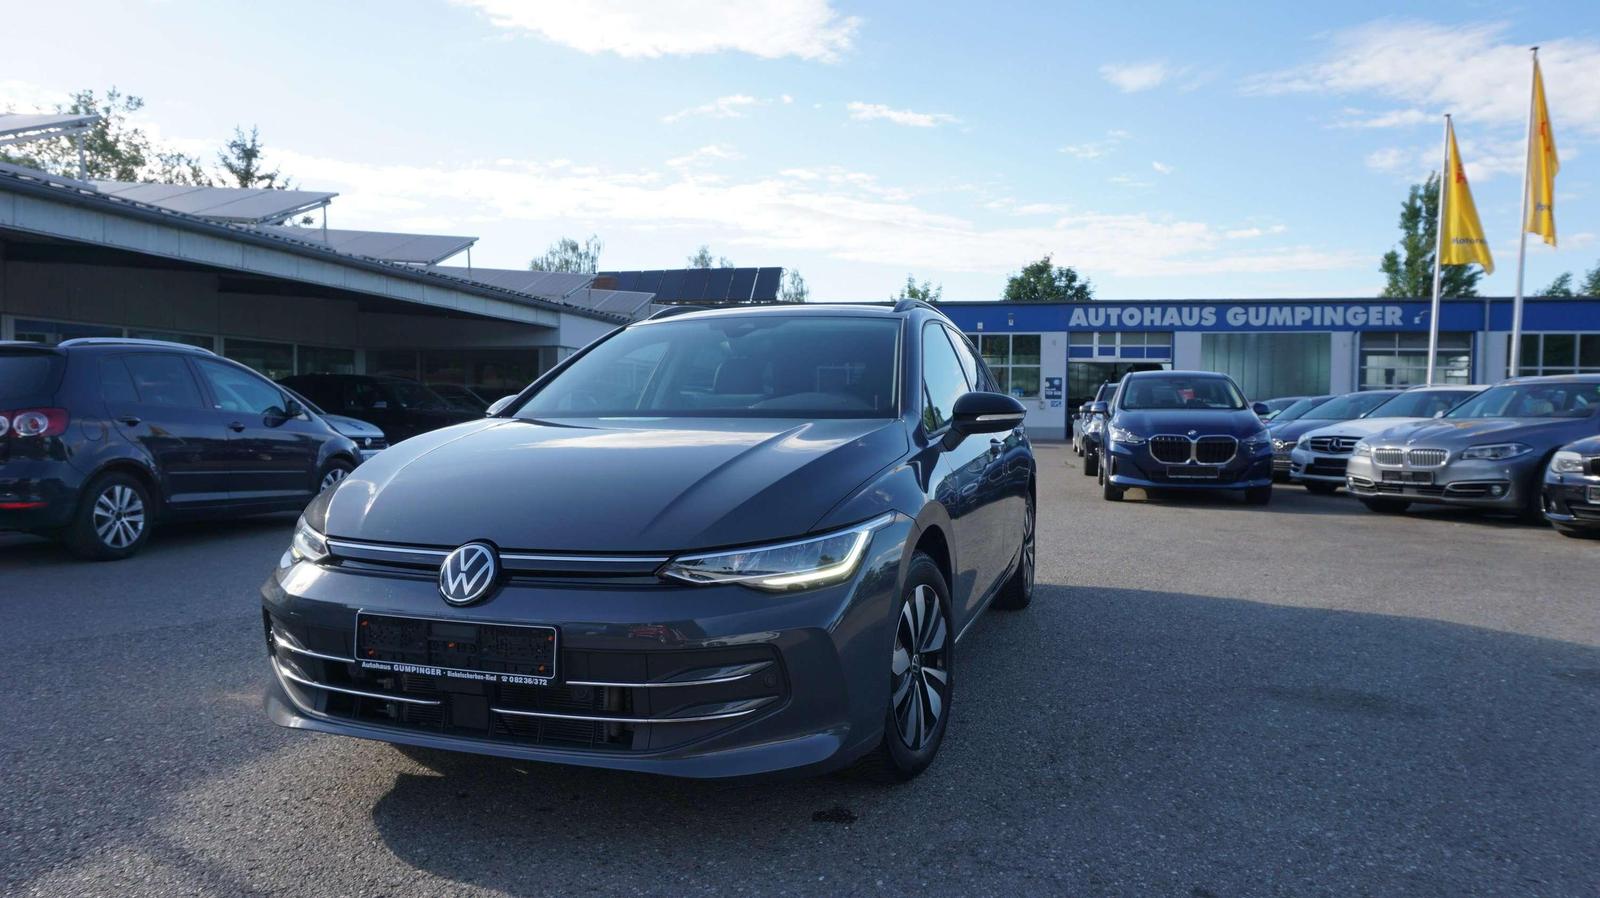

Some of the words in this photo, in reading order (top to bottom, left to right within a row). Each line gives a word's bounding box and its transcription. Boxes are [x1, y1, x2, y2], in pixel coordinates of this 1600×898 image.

[1068, 306, 1217, 327] AUTOHAUS
[1226, 305, 1403, 327] GUMPINGER
[361, 661, 391, 671] Autohaus
[393, 664, 442, 676] GUMPINGER
